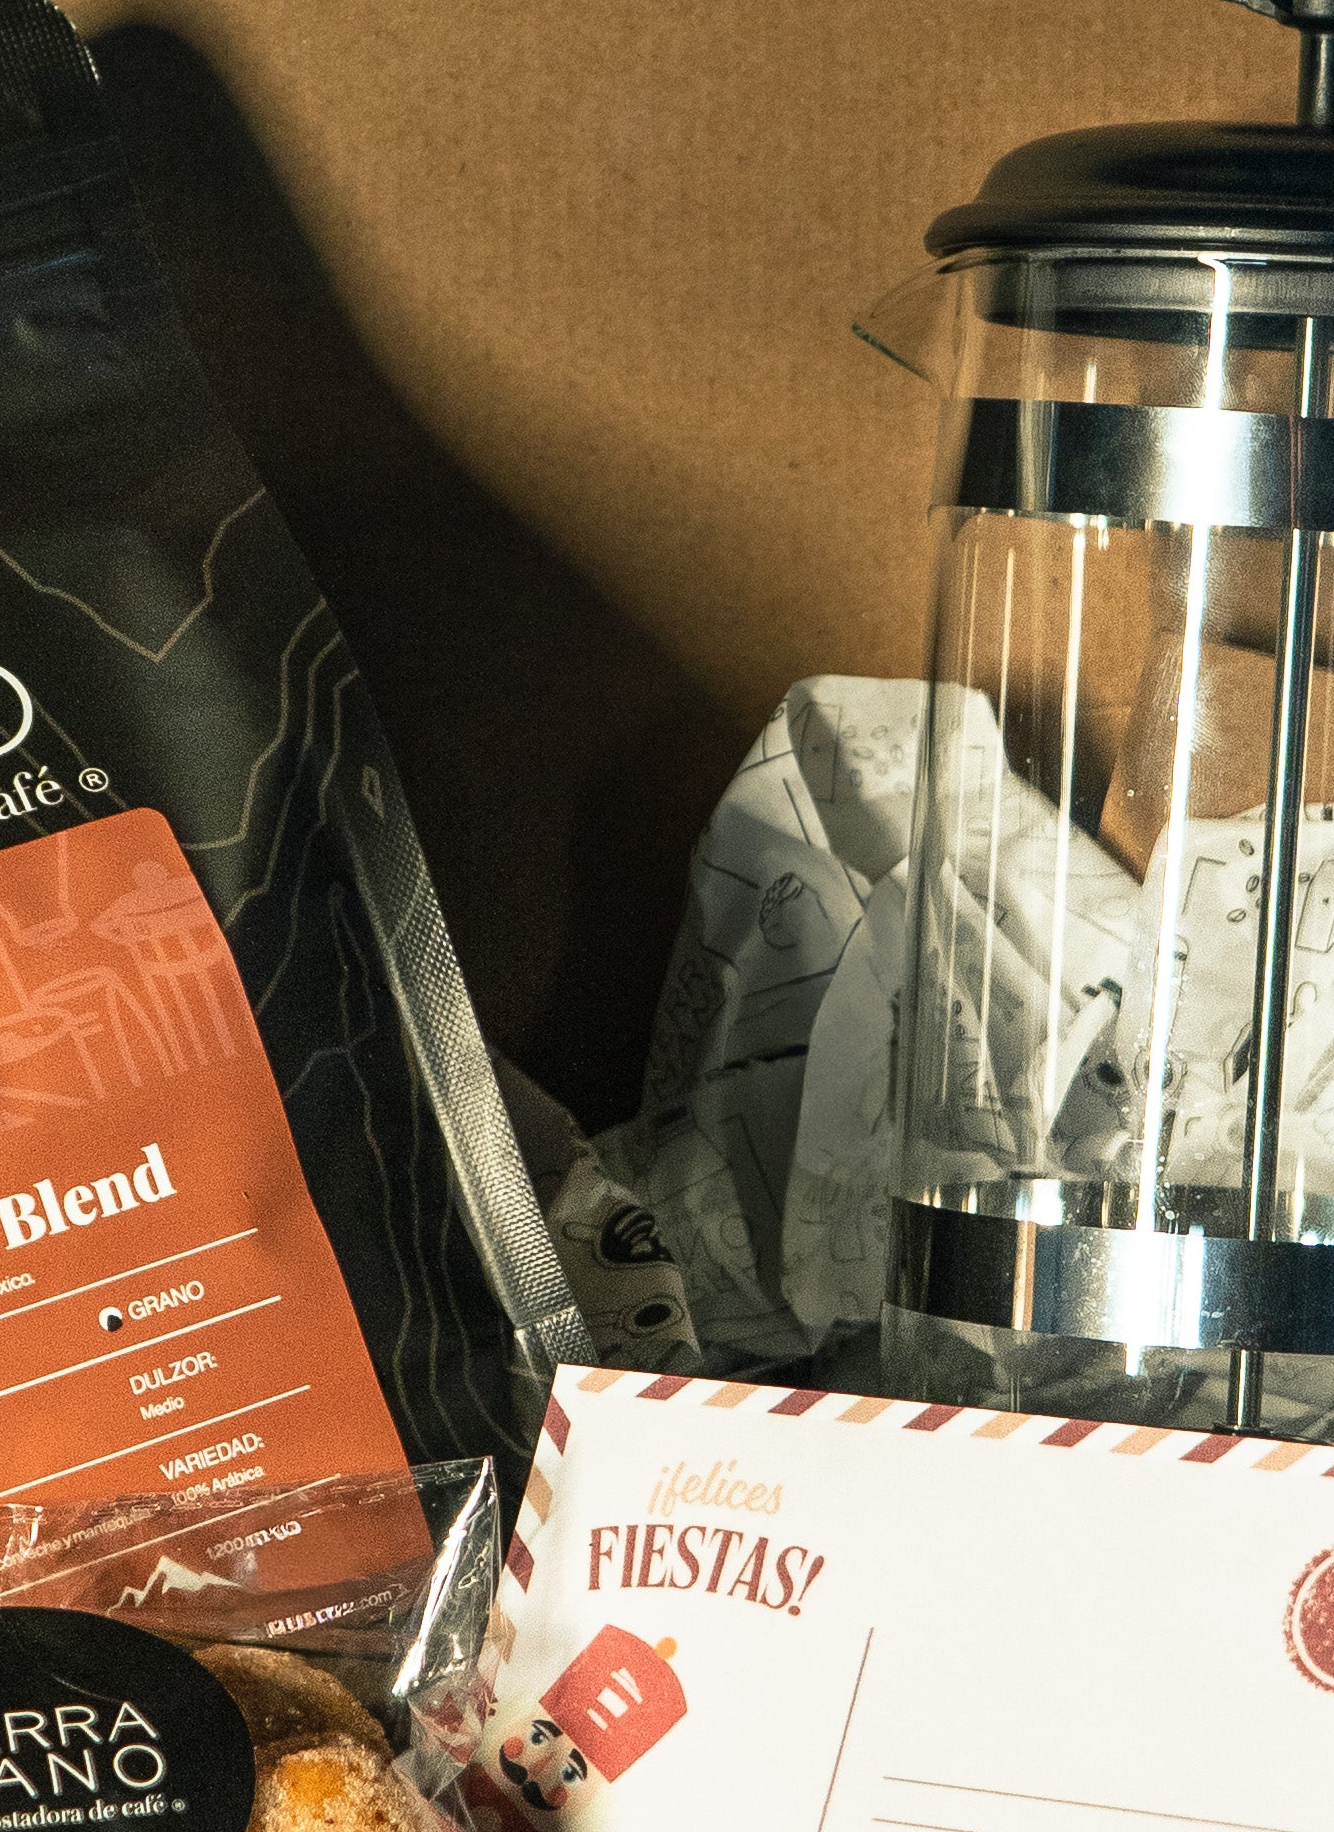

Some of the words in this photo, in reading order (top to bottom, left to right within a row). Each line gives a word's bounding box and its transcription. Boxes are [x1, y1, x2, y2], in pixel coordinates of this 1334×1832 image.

[128, 1279, 206, 1323] GRANO
[128, 1351, 218, 1397] DULZOR:
[140, 1395, 186, 1423] Medio
[159, 1432, 266, 1481] VARIEDAD:
[212, 1464, 266, 1494] Arábica
[586, 1522, 825, 1619] FIESTAS!
[88, 1798, 117, 1821] de
[120, 1791, 166, 1818] café
